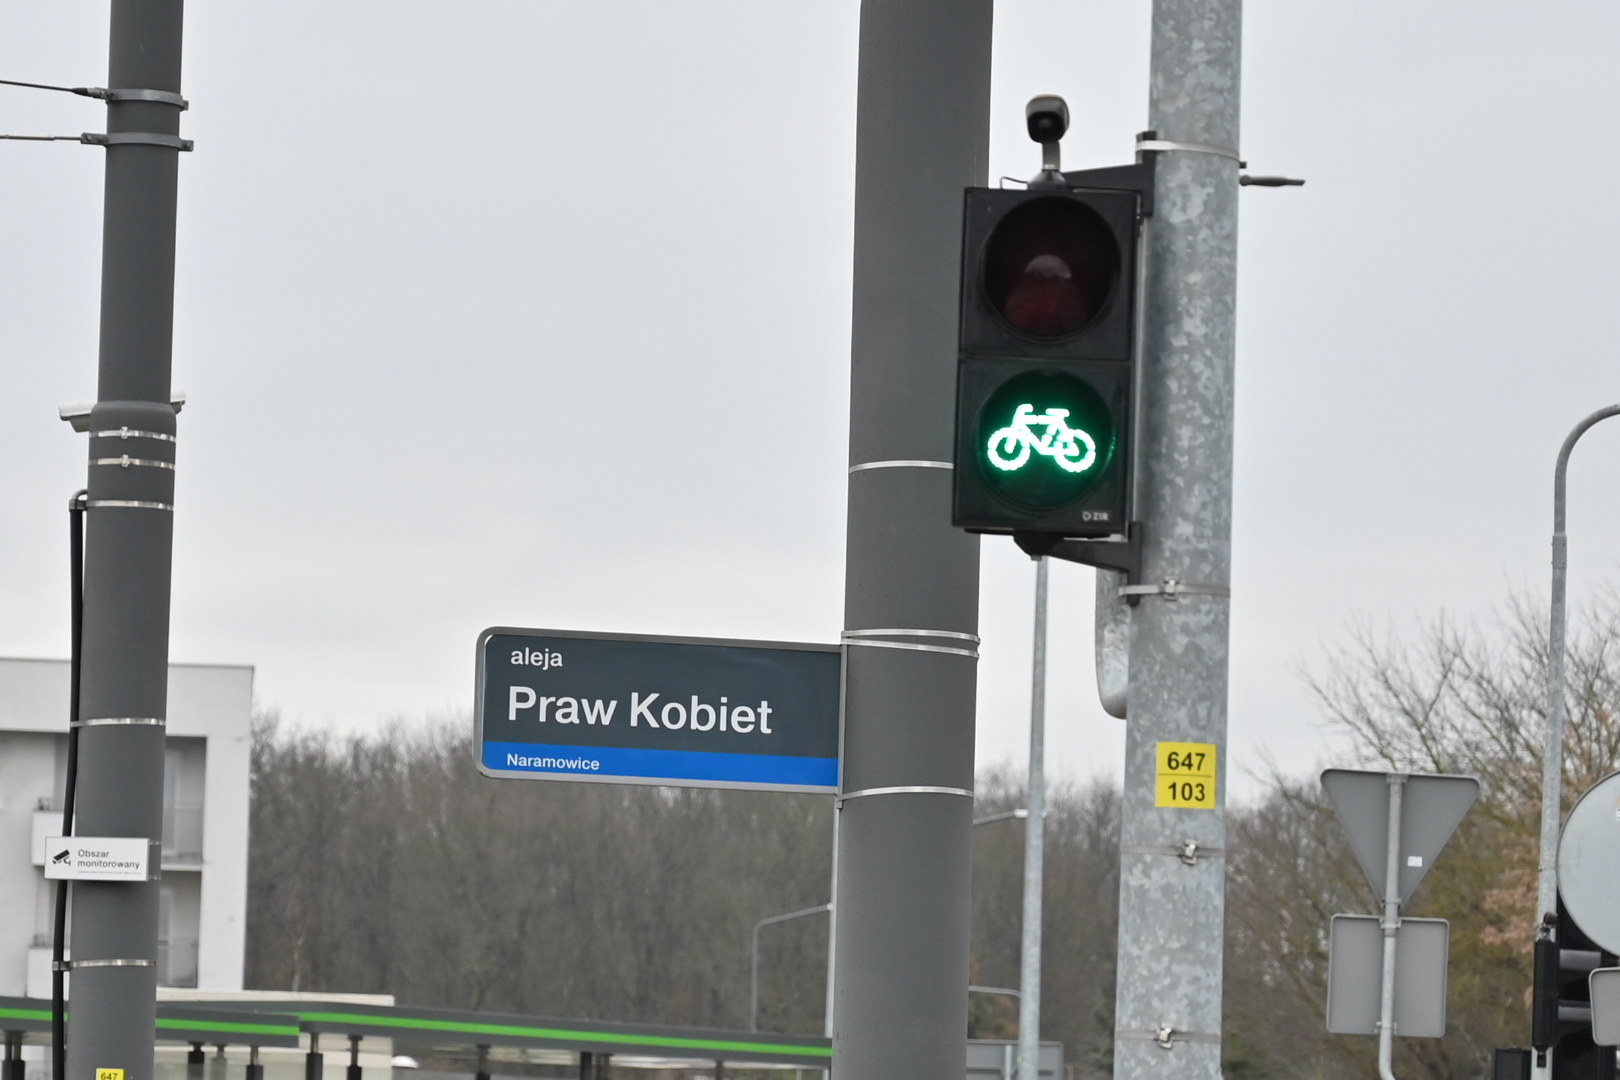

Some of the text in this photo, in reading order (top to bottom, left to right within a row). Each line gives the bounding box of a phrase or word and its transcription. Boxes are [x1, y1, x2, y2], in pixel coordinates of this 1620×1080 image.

[510, 647, 563, 670] aleja
[508, 685, 773, 735] Praw Kobiet
[506, 753, 600, 771] Naramowice
[1167, 751, 1206, 771] 647
[1167, 782, 1206, 802] 103
[77, 849, 110, 858] Obszar
[77, 859, 140, 870] monitorowany
[100, 1072, 118, 1080] 647
